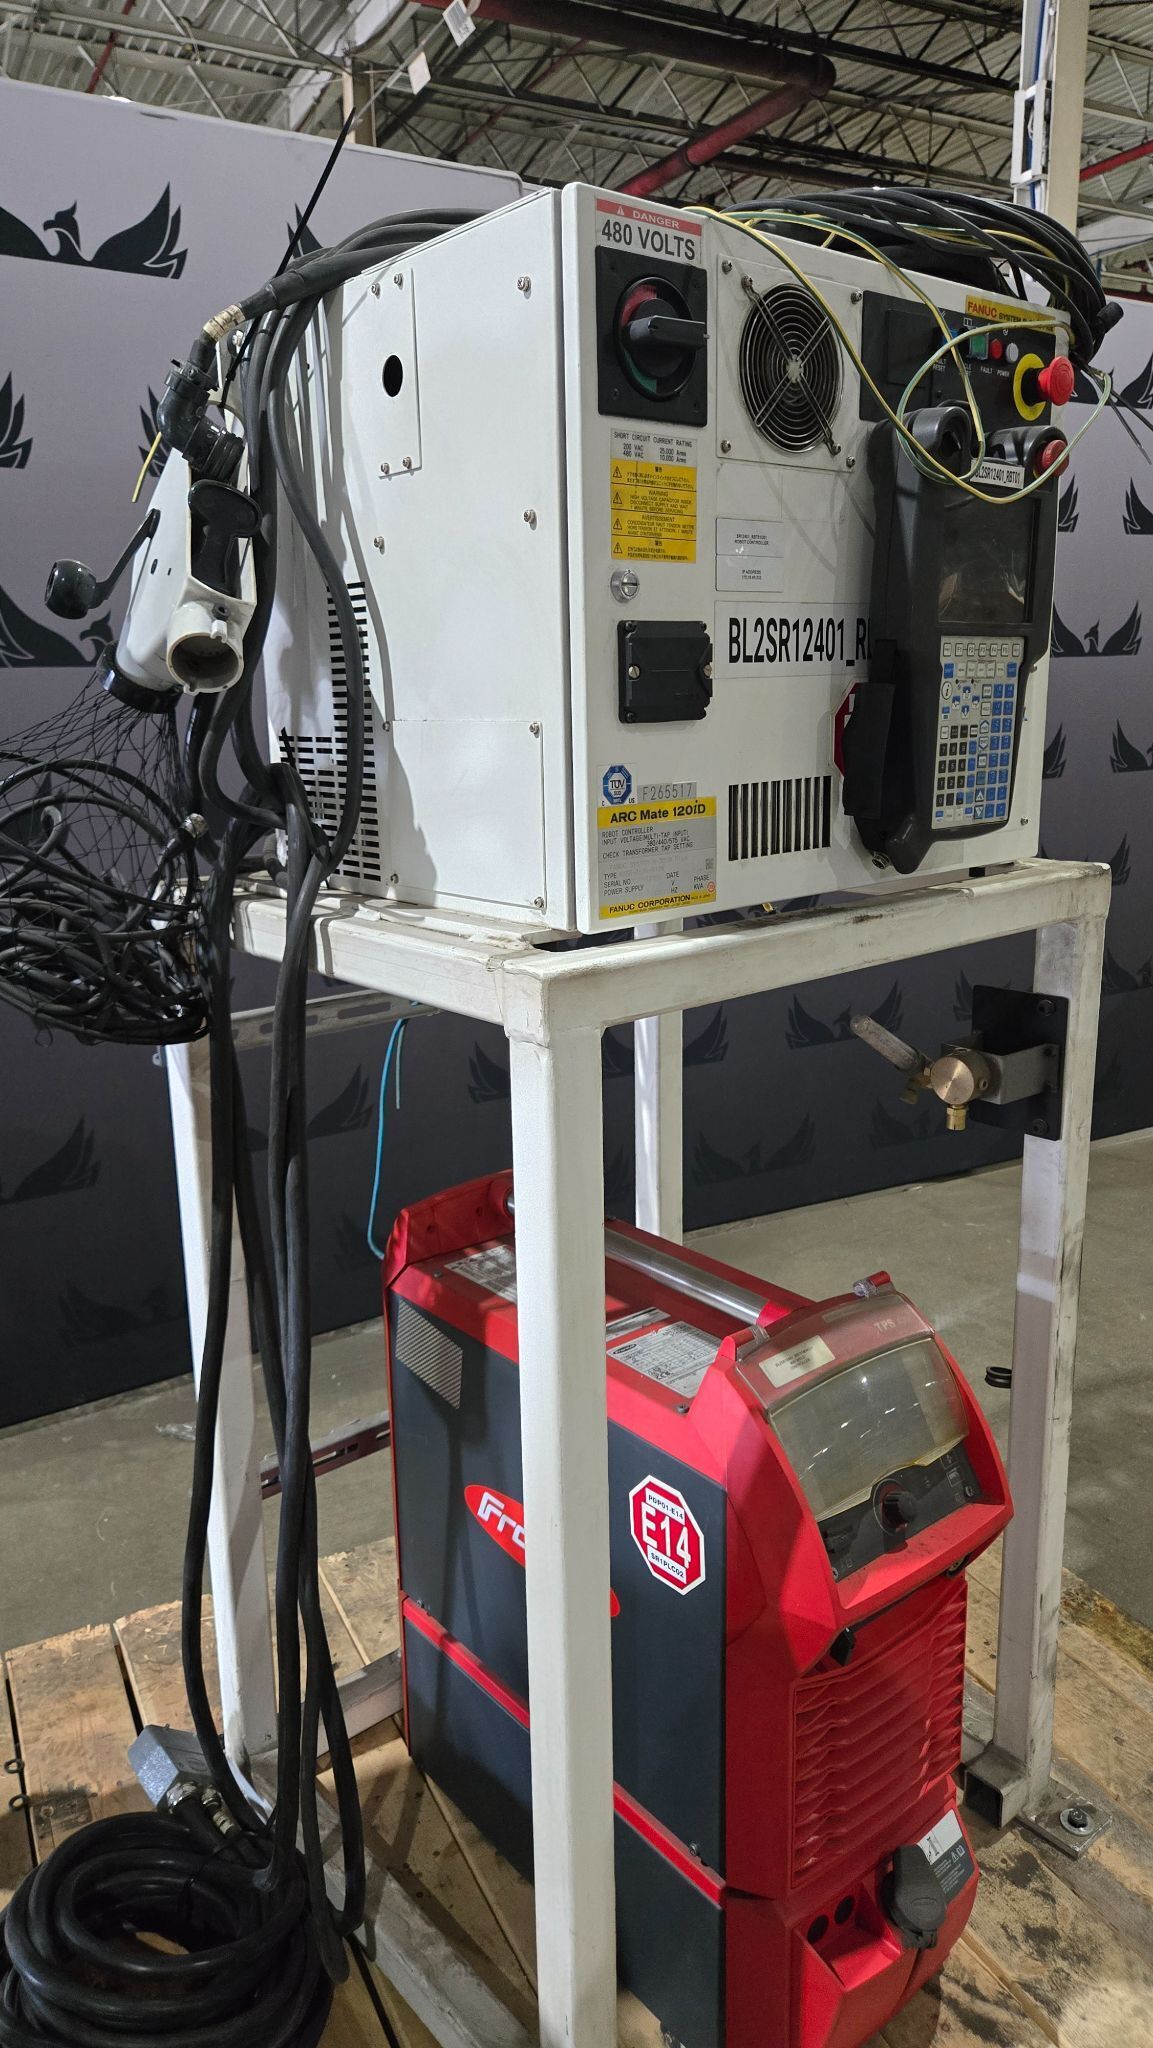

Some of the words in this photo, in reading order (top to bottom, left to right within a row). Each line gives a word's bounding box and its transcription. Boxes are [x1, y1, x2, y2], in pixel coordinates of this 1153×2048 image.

[632, 210, 681, 229] DANGER
[602, 219, 632, 245] 480
[638, 226, 695, 260] VOLTS
[968, 302, 997, 318] FANUC
[614, 432, 629, 440] SHORT
[632, 433, 650, 442] CIRCUIT
[653, 436, 674, 445] CURRENT
[676, 439, 692, 448] RATING
[634, 451, 644, 459] VAC
[729, 618, 872, 667] BL2SR12401_R
[642, 783, 693, 801] F265517
[610, 810, 637, 823] ARC
[640, 809, 669, 820] Mate
[673, 800, 706, 817] 120iD
[602, 830, 618, 838] ROBOT
[621, 826, 653, 836] CONTROLLER
[602, 837, 617, 845] INPUT
[603, 851, 619, 859] CHECK
[623, 846, 658, 856] TRANSFORMER
[673, 841, 693, 850] SETTING
[604, 872, 616, 880] TYPE
[666, 871, 680, 879] DATE
[604, 880, 621, 888] SERIAL
[694, 874, 709, 882] PHASE
[604, 887, 622, 896] POWER
[625, 885, 644, 893] SUPPLY
[610, 903, 635, 914] FANUC
[638, 895, 690, 909] CORPORATION
[873, 1318, 896, 1333] TPS
[641, 1501, 691, 1570] E14
[650, 1552, 684, 1579] SR1PLC02
